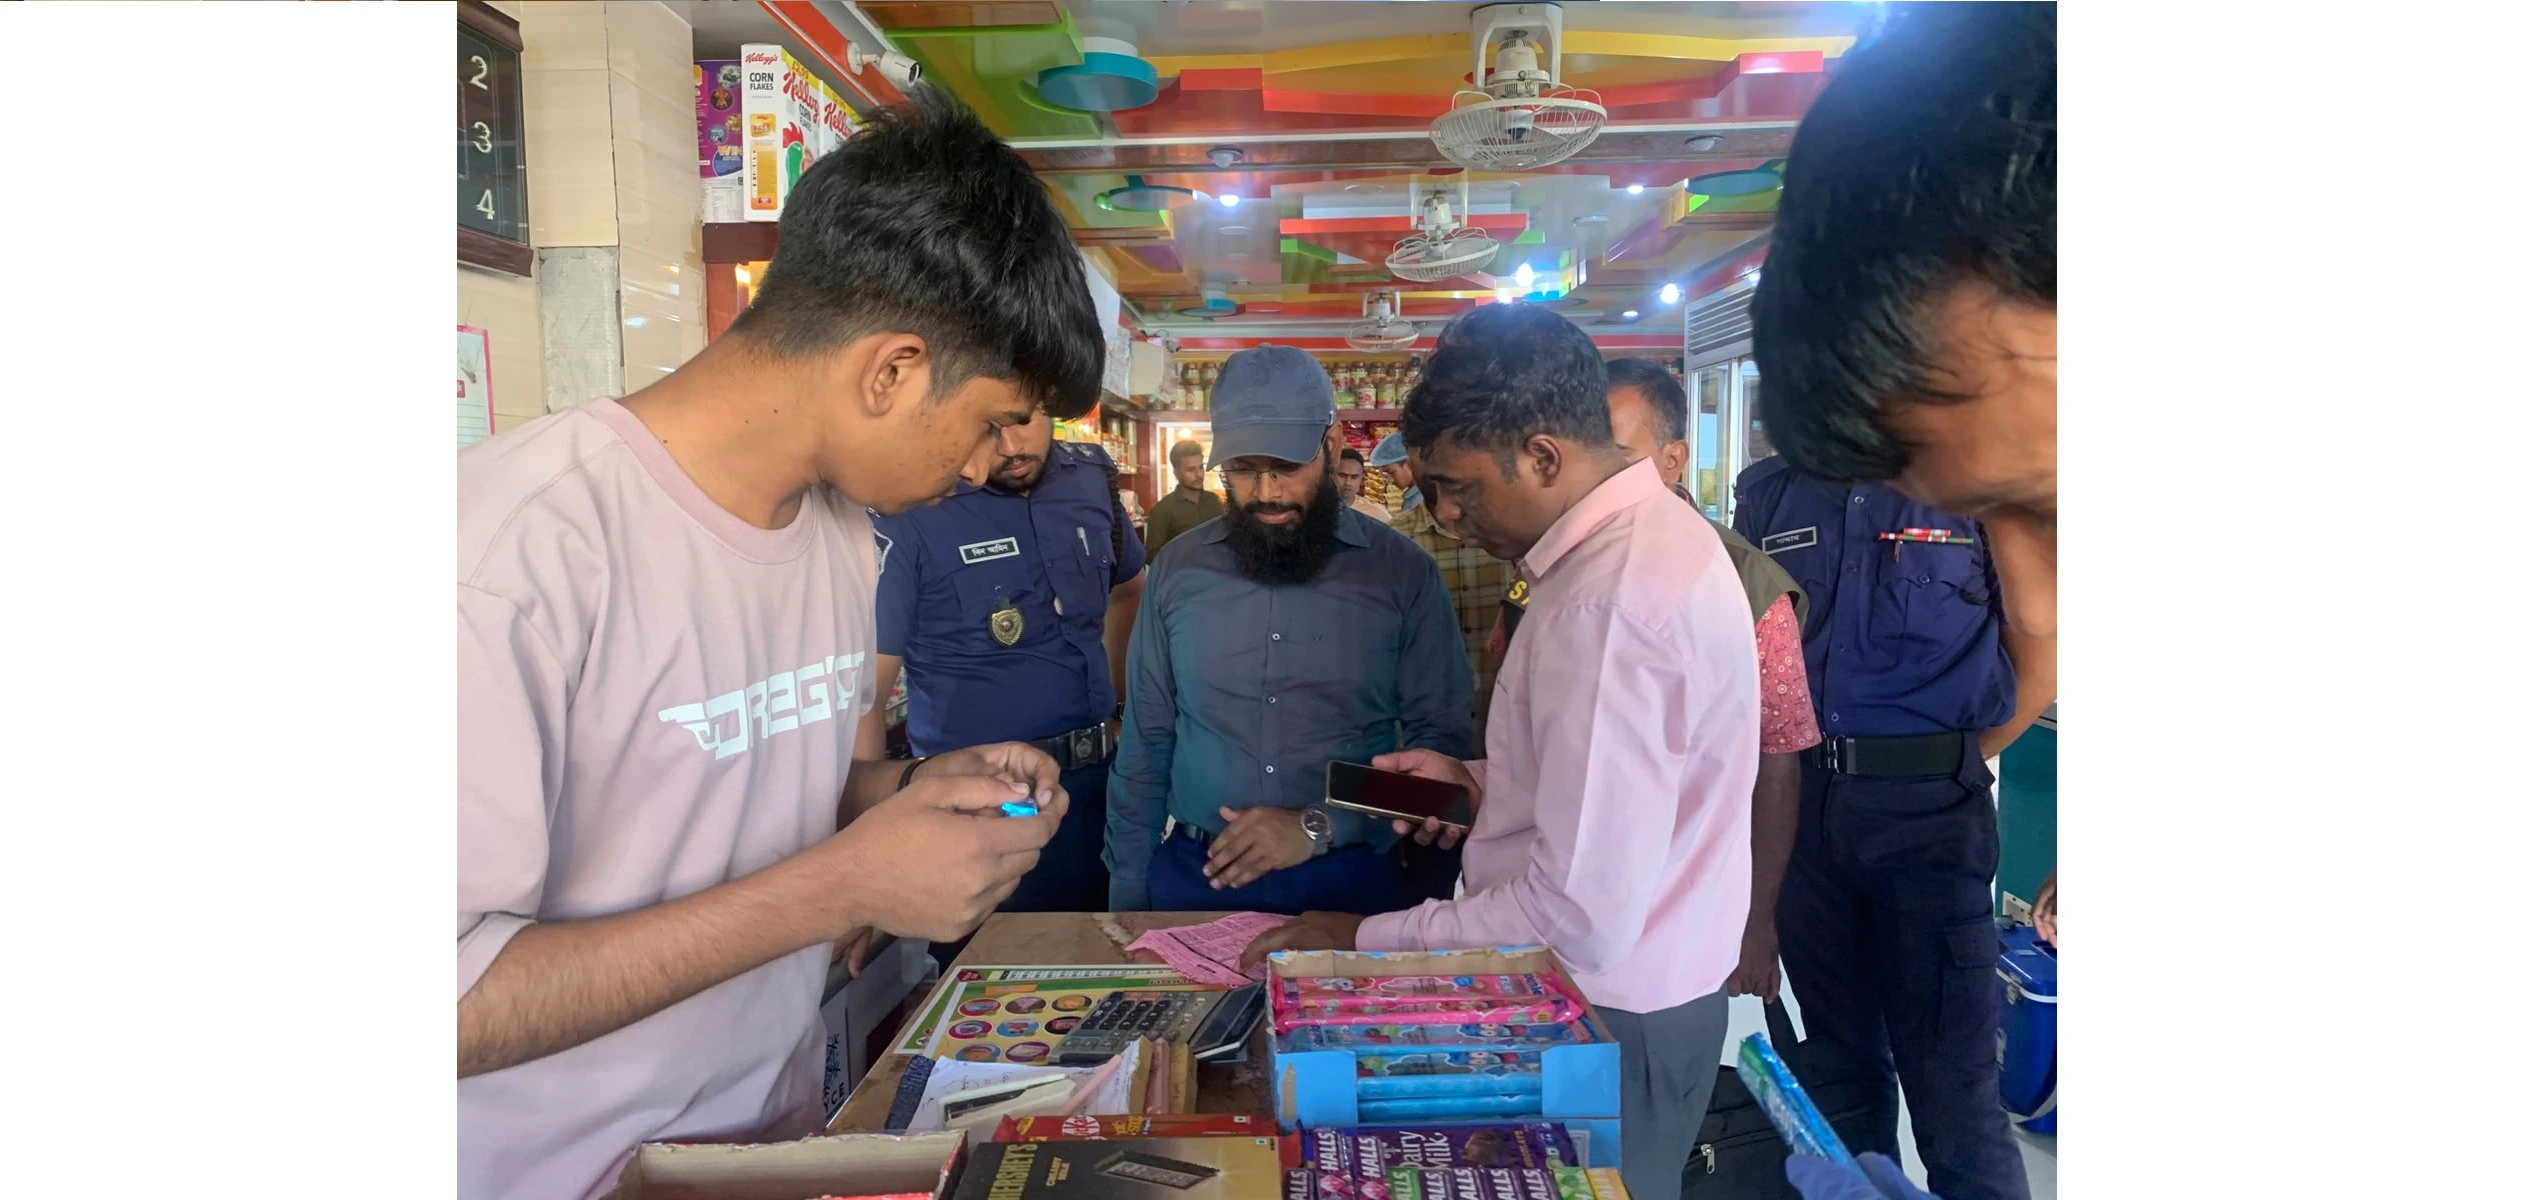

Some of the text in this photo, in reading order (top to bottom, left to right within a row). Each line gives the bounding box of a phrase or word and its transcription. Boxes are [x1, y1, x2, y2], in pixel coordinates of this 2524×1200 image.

[468, 55, 488, 90] 2
[745, 52, 778, 65] Kellogg's
[749, 72, 774, 82] CORN
[749, 83, 774, 91] FLAKES
[473, 121, 492, 153] 3
[476, 189, 495, 220] 4
[1317, 1131, 1340, 1171] HALLS
[1357, 1136, 1382, 1178] HALLS
[988, 1143, 1038, 1200] HERSHEY'S
[1290, 1171, 1310, 1200] ALLS
[1392, 1170, 1412, 1200] ALLS
[1425, 1171, 1447, 1200] ALLS
[1453, 1166, 1480, 1200] ALLS
[1490, 1167, 1518, 1200] ALLS
[1522, 1167, 1551, 1200] ALLS
